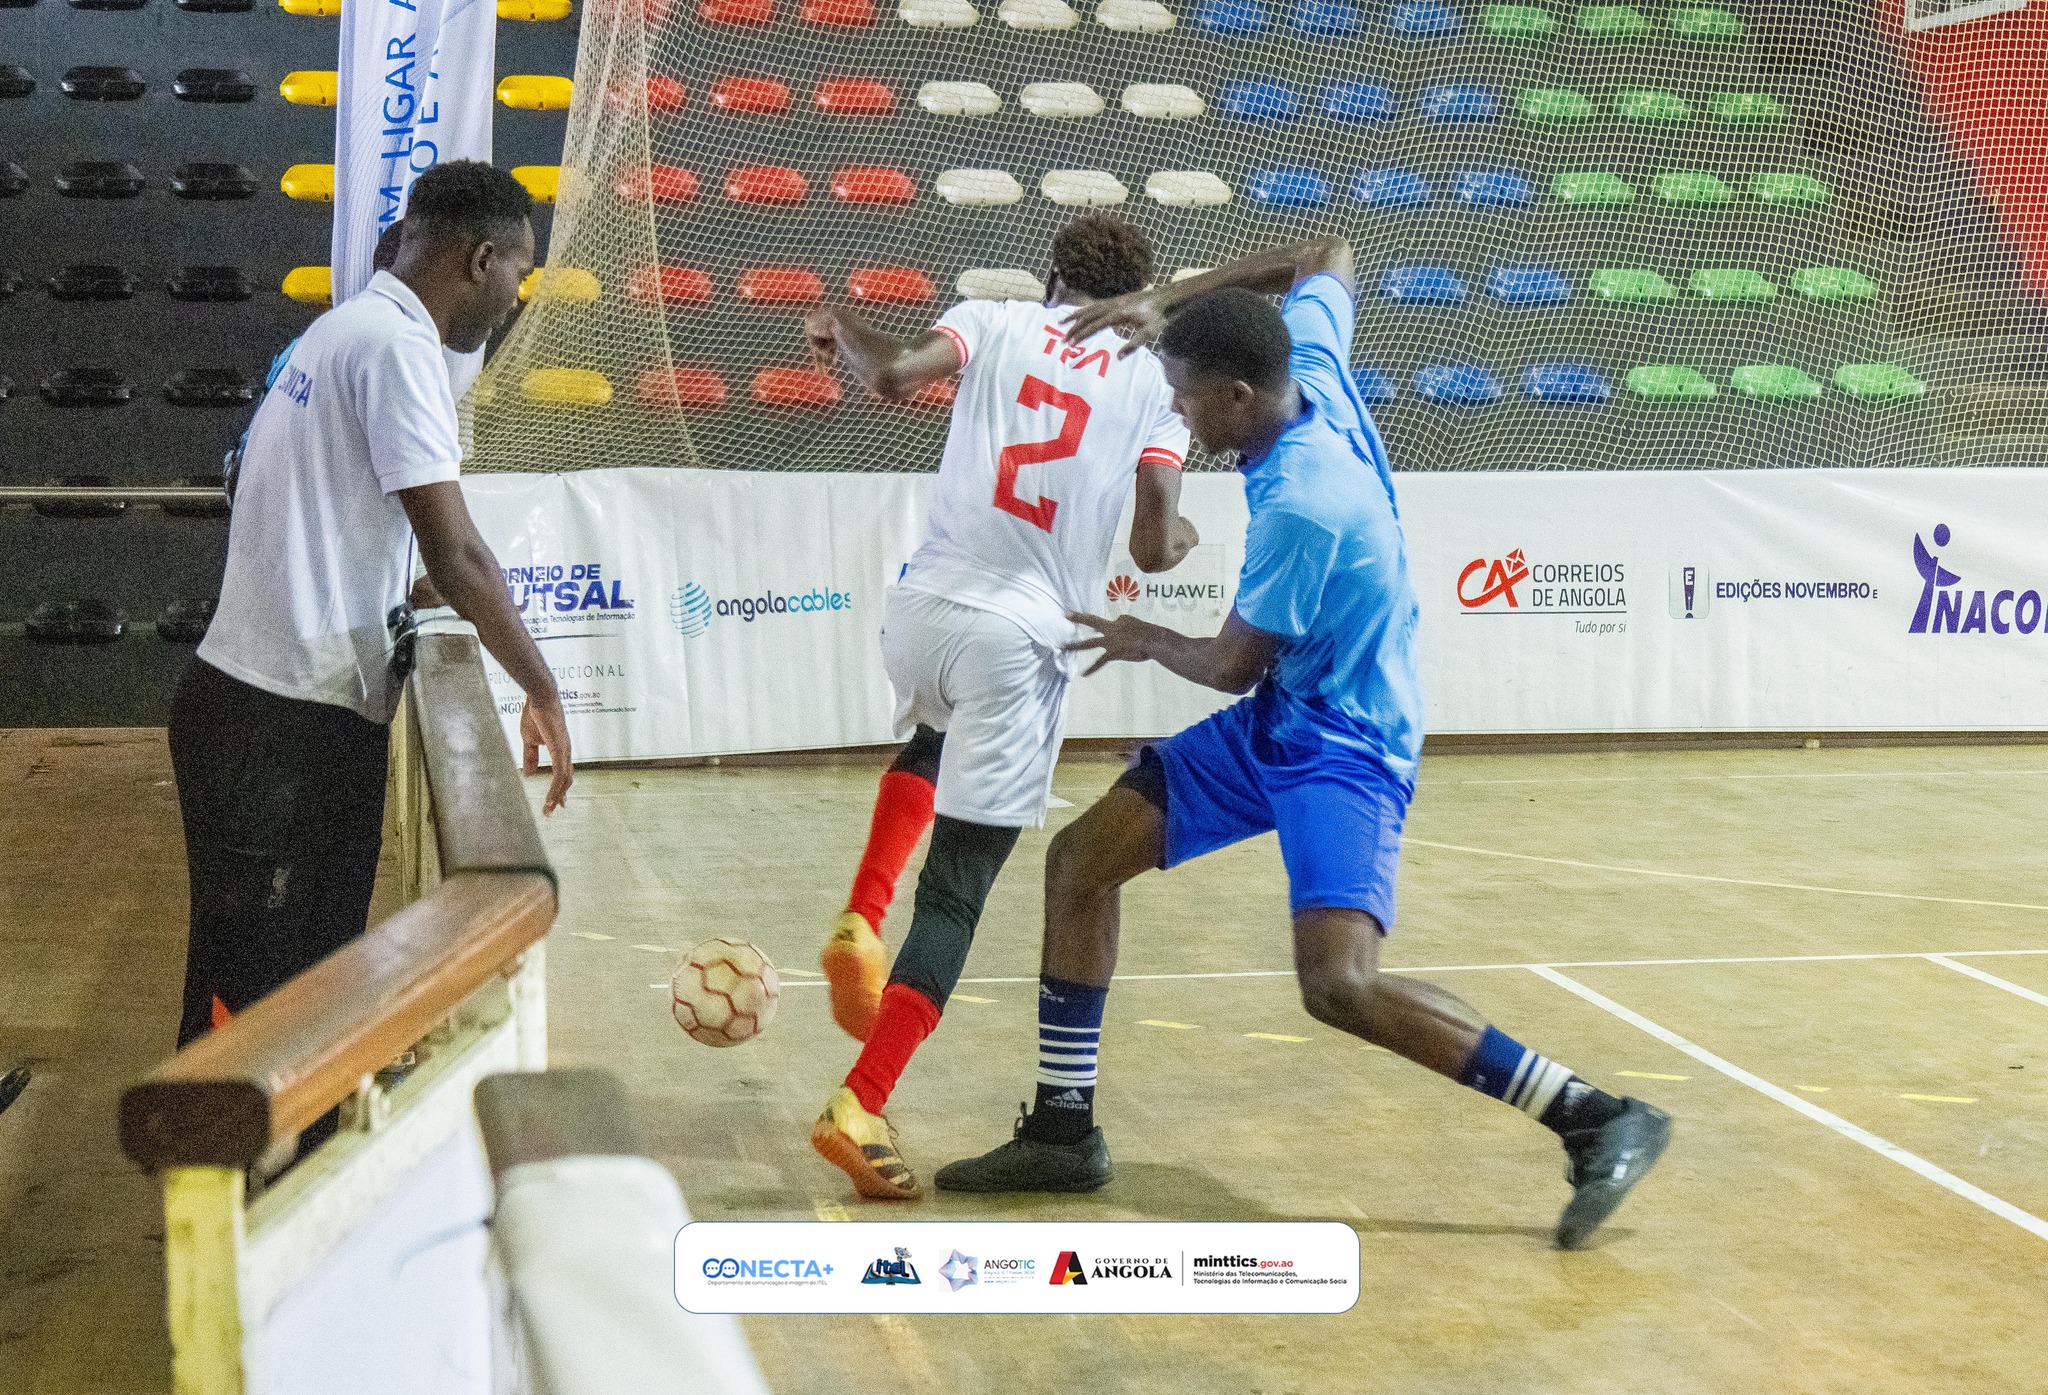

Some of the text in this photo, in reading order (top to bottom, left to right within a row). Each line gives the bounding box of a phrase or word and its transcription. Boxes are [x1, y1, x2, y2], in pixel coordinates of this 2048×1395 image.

[381, 33, 416, 159] LIGAR
[992, 373, 1092, 534] 2
[571, 563, 601, 580] DE
[1532, 564, 1625, 583] CORREIOS
[1146, 583, 1225, 599] HUAWEI
[1532, 588, 1627, 607] DE ANGOLA
[1716, 580, 1781, 603] EDIÇÕES
[1785, 582, 1870, 599] NOVEMBRO
[1908, 558, 2048, 635] INACO
[716, 586, 852, 622] angolacables
[597, 611, 636, 621] Informação
[1576, 620, 1627, 636] Tudo por si
[1045, 1100, 1090, 1111] adidas
